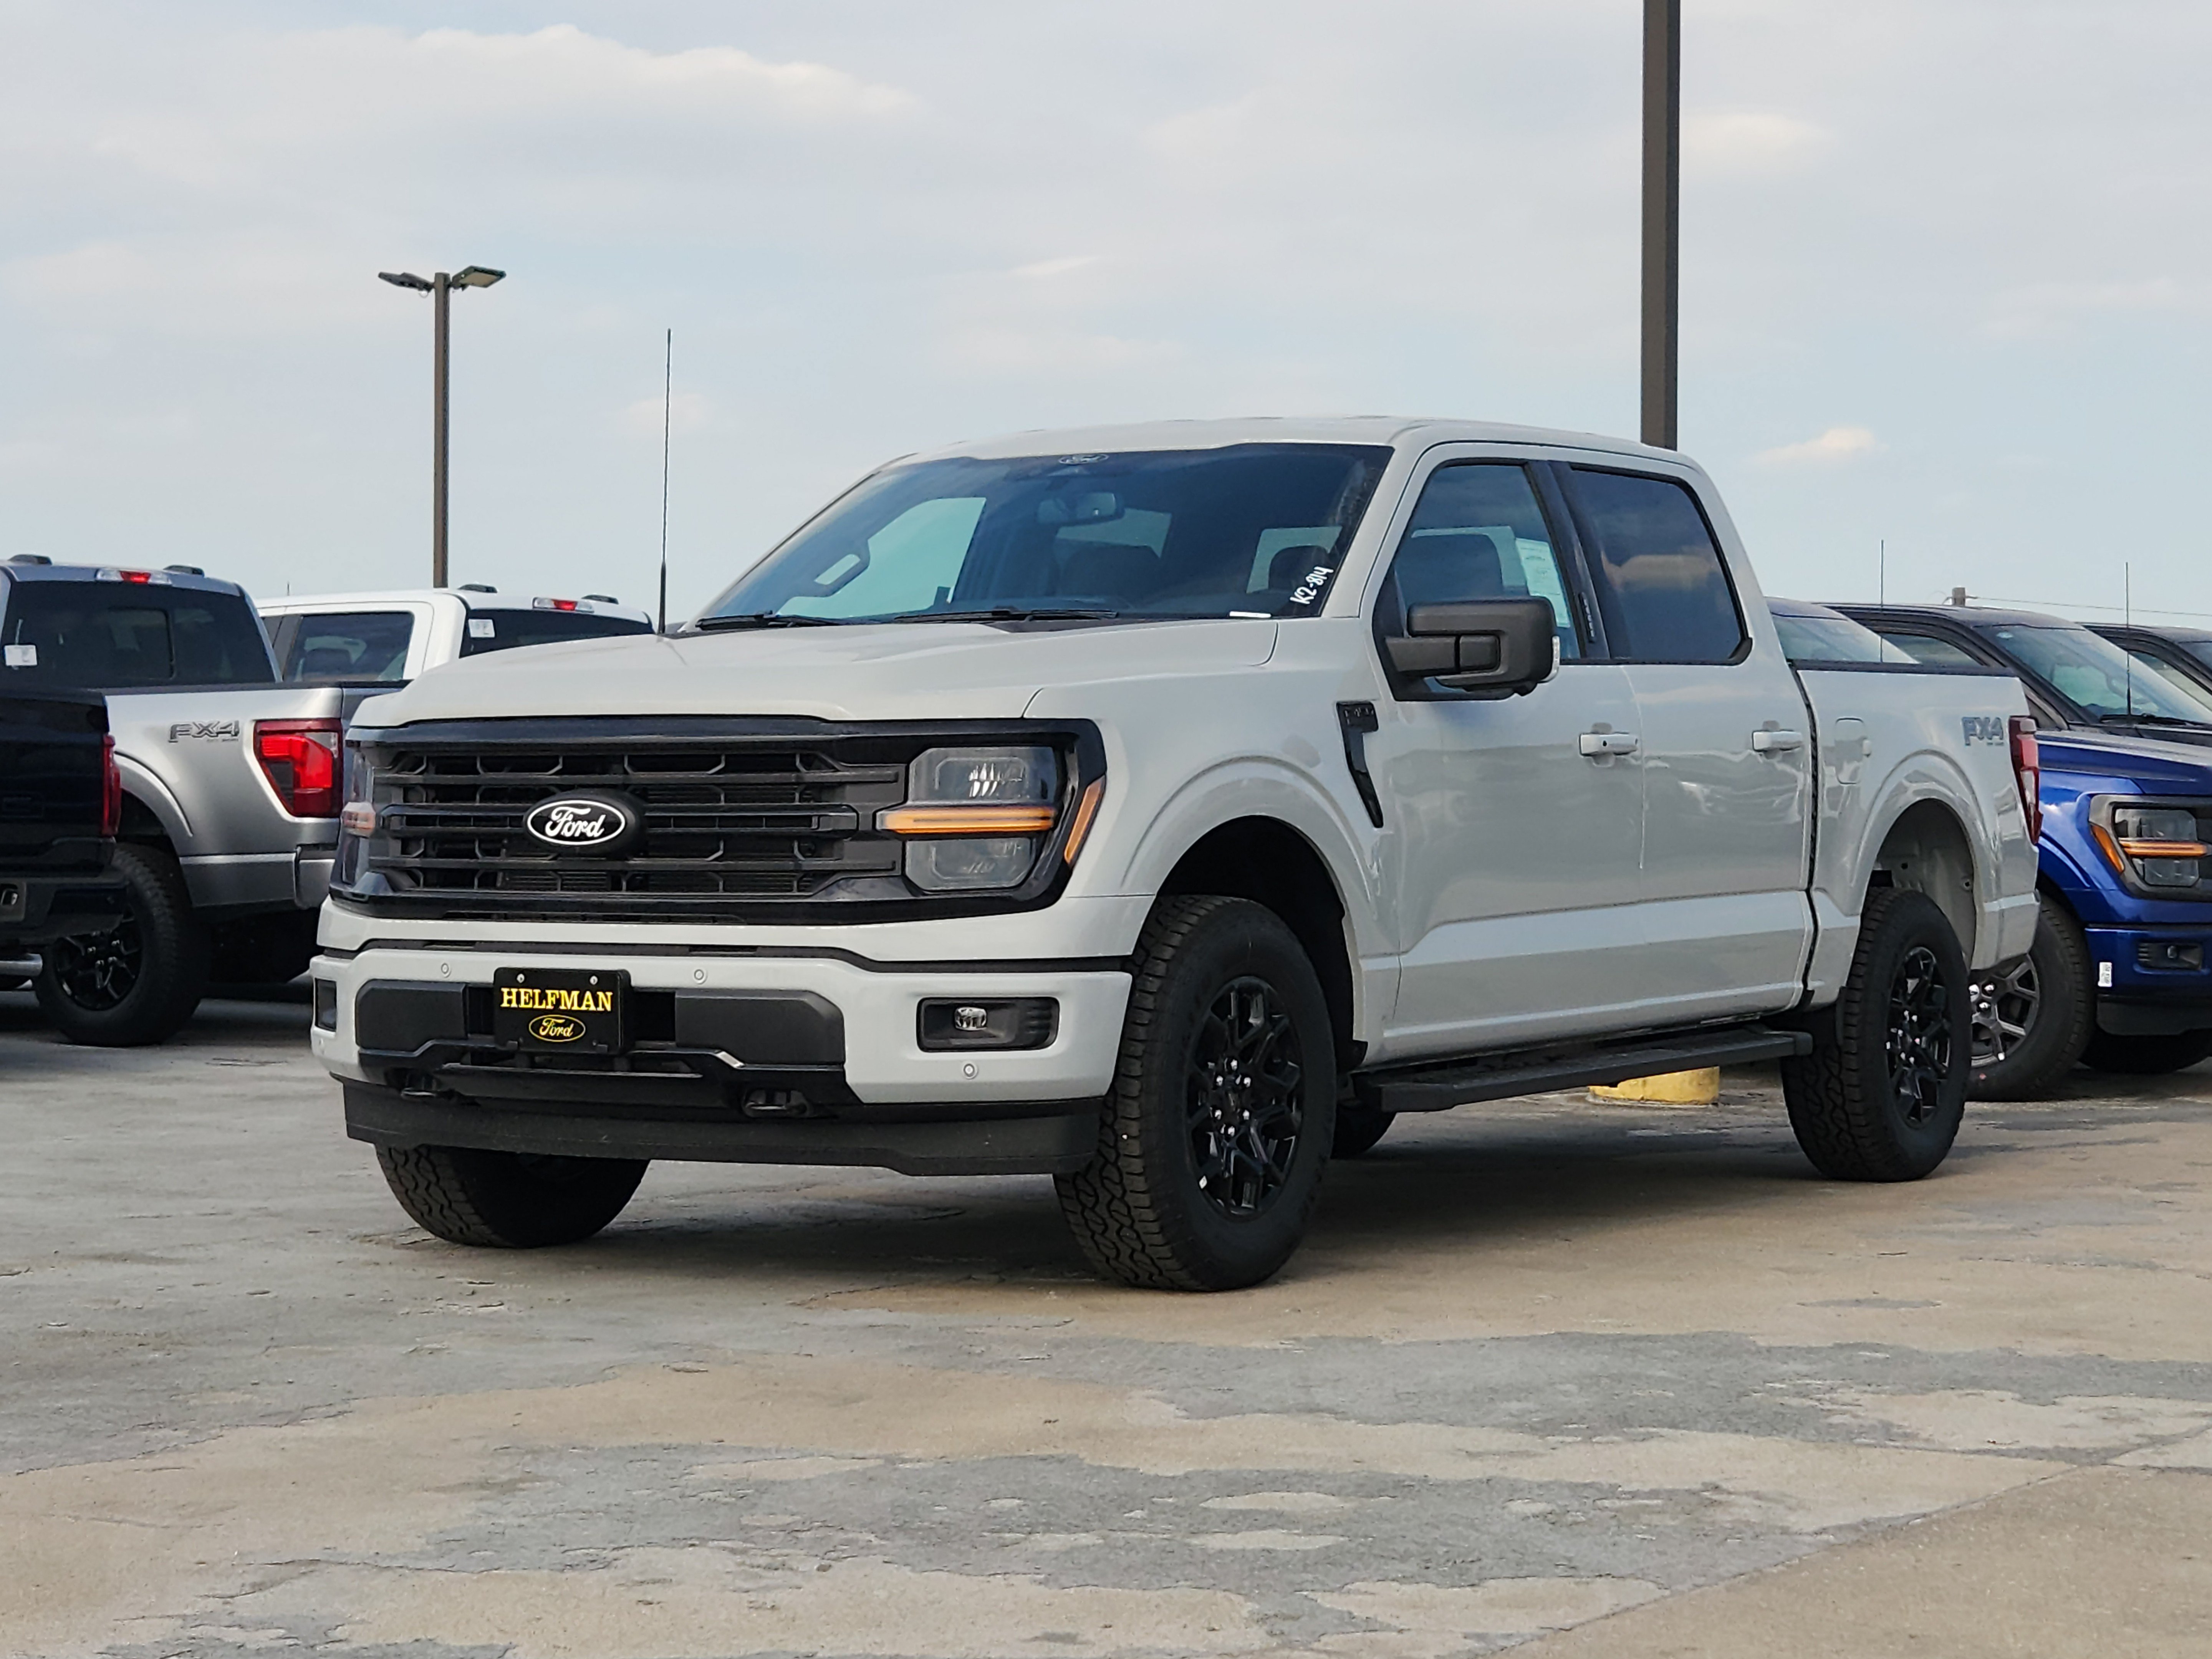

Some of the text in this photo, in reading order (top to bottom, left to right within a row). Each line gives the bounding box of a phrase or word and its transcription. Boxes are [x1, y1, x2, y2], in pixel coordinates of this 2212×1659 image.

[1290, 566, 1334, 604] K2-814
[168, 720, 239, 743] FX4
[1962, 717, 2003, 746] FX4
[545, 806, 606, 837] Ford
[500, 987, 613, 1011] HELFMAN
[539, 1018, 574, 1037] Ford
